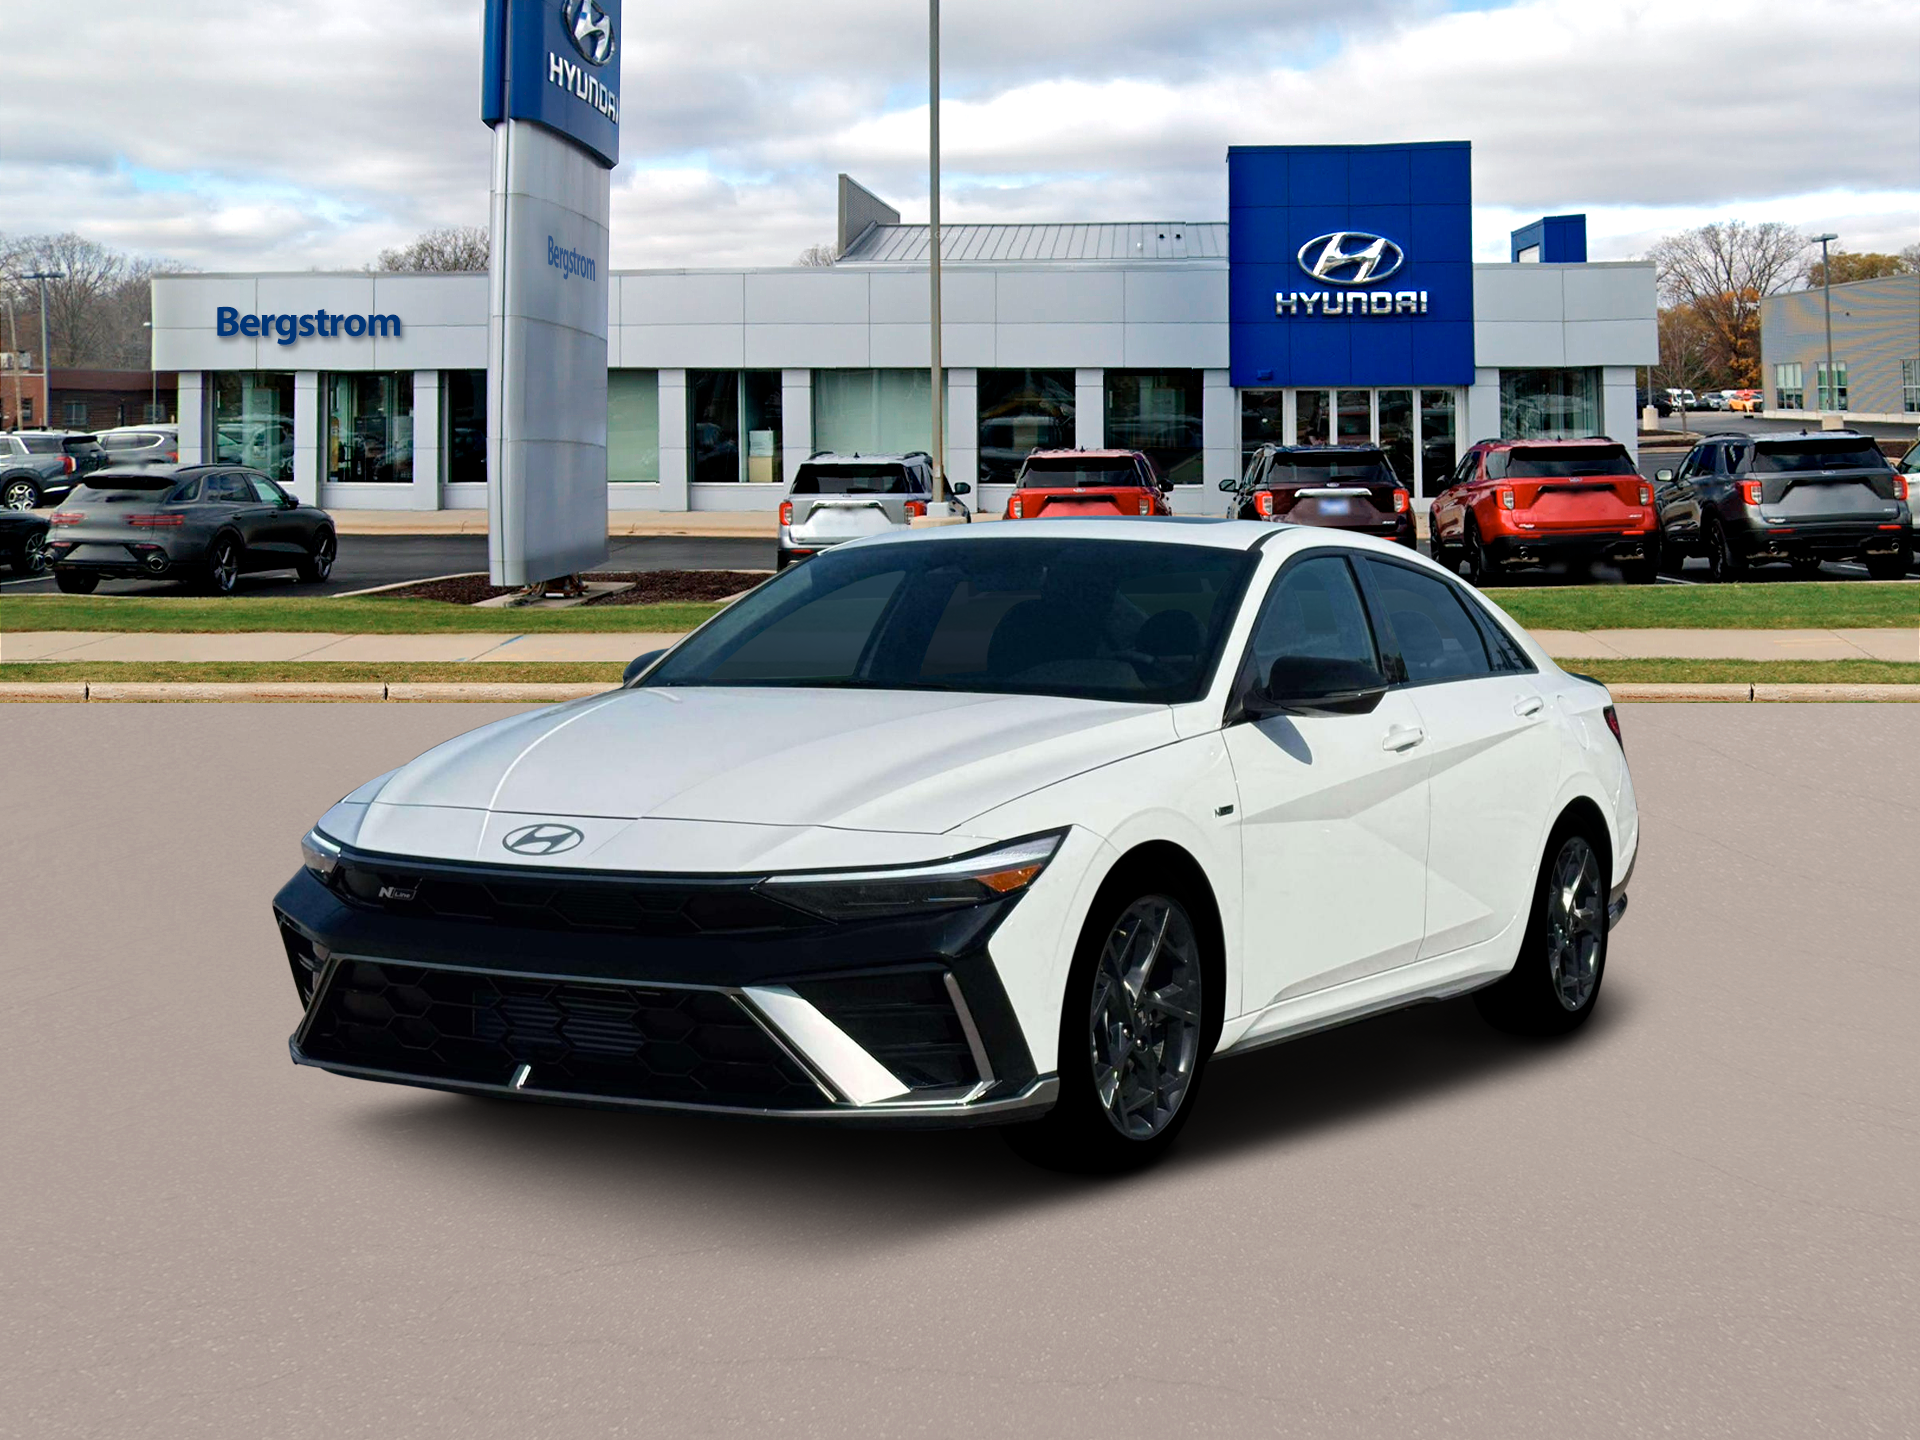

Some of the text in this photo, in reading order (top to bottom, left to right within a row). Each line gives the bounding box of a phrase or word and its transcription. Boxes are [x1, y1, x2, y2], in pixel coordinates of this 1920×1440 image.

[549, 52, 619, 124] HYUNDAI
[547, 235, 596, 281] Bergstrom
[1275, 290, 1428, 315] HYUNDAI
[216, 306, 401, 346] Bergstrom
[378, 886, 394, 898] N
